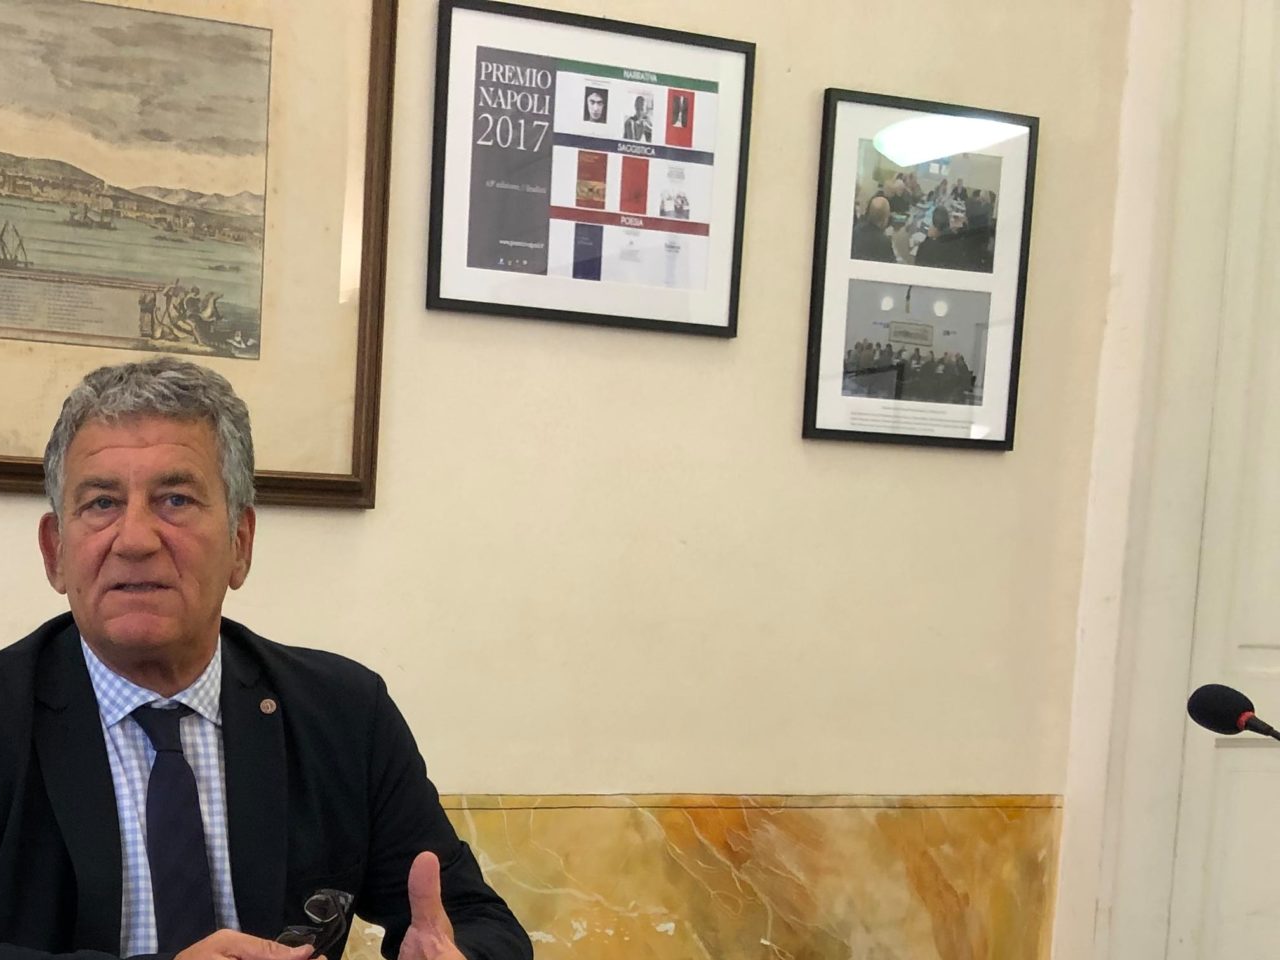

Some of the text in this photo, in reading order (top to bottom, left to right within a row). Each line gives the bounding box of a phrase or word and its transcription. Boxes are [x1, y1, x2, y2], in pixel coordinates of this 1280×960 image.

[480, 62, 551, 89] PREMIO
[624, 70, 657, 82] NARRATIVA
[479, 86, 550, 115] NAPOLI
[477, 114, 549, 152] 2017
[618, 143, 656, 155] SAGGISTICA
[621, 216, 643, 226] POESIA
